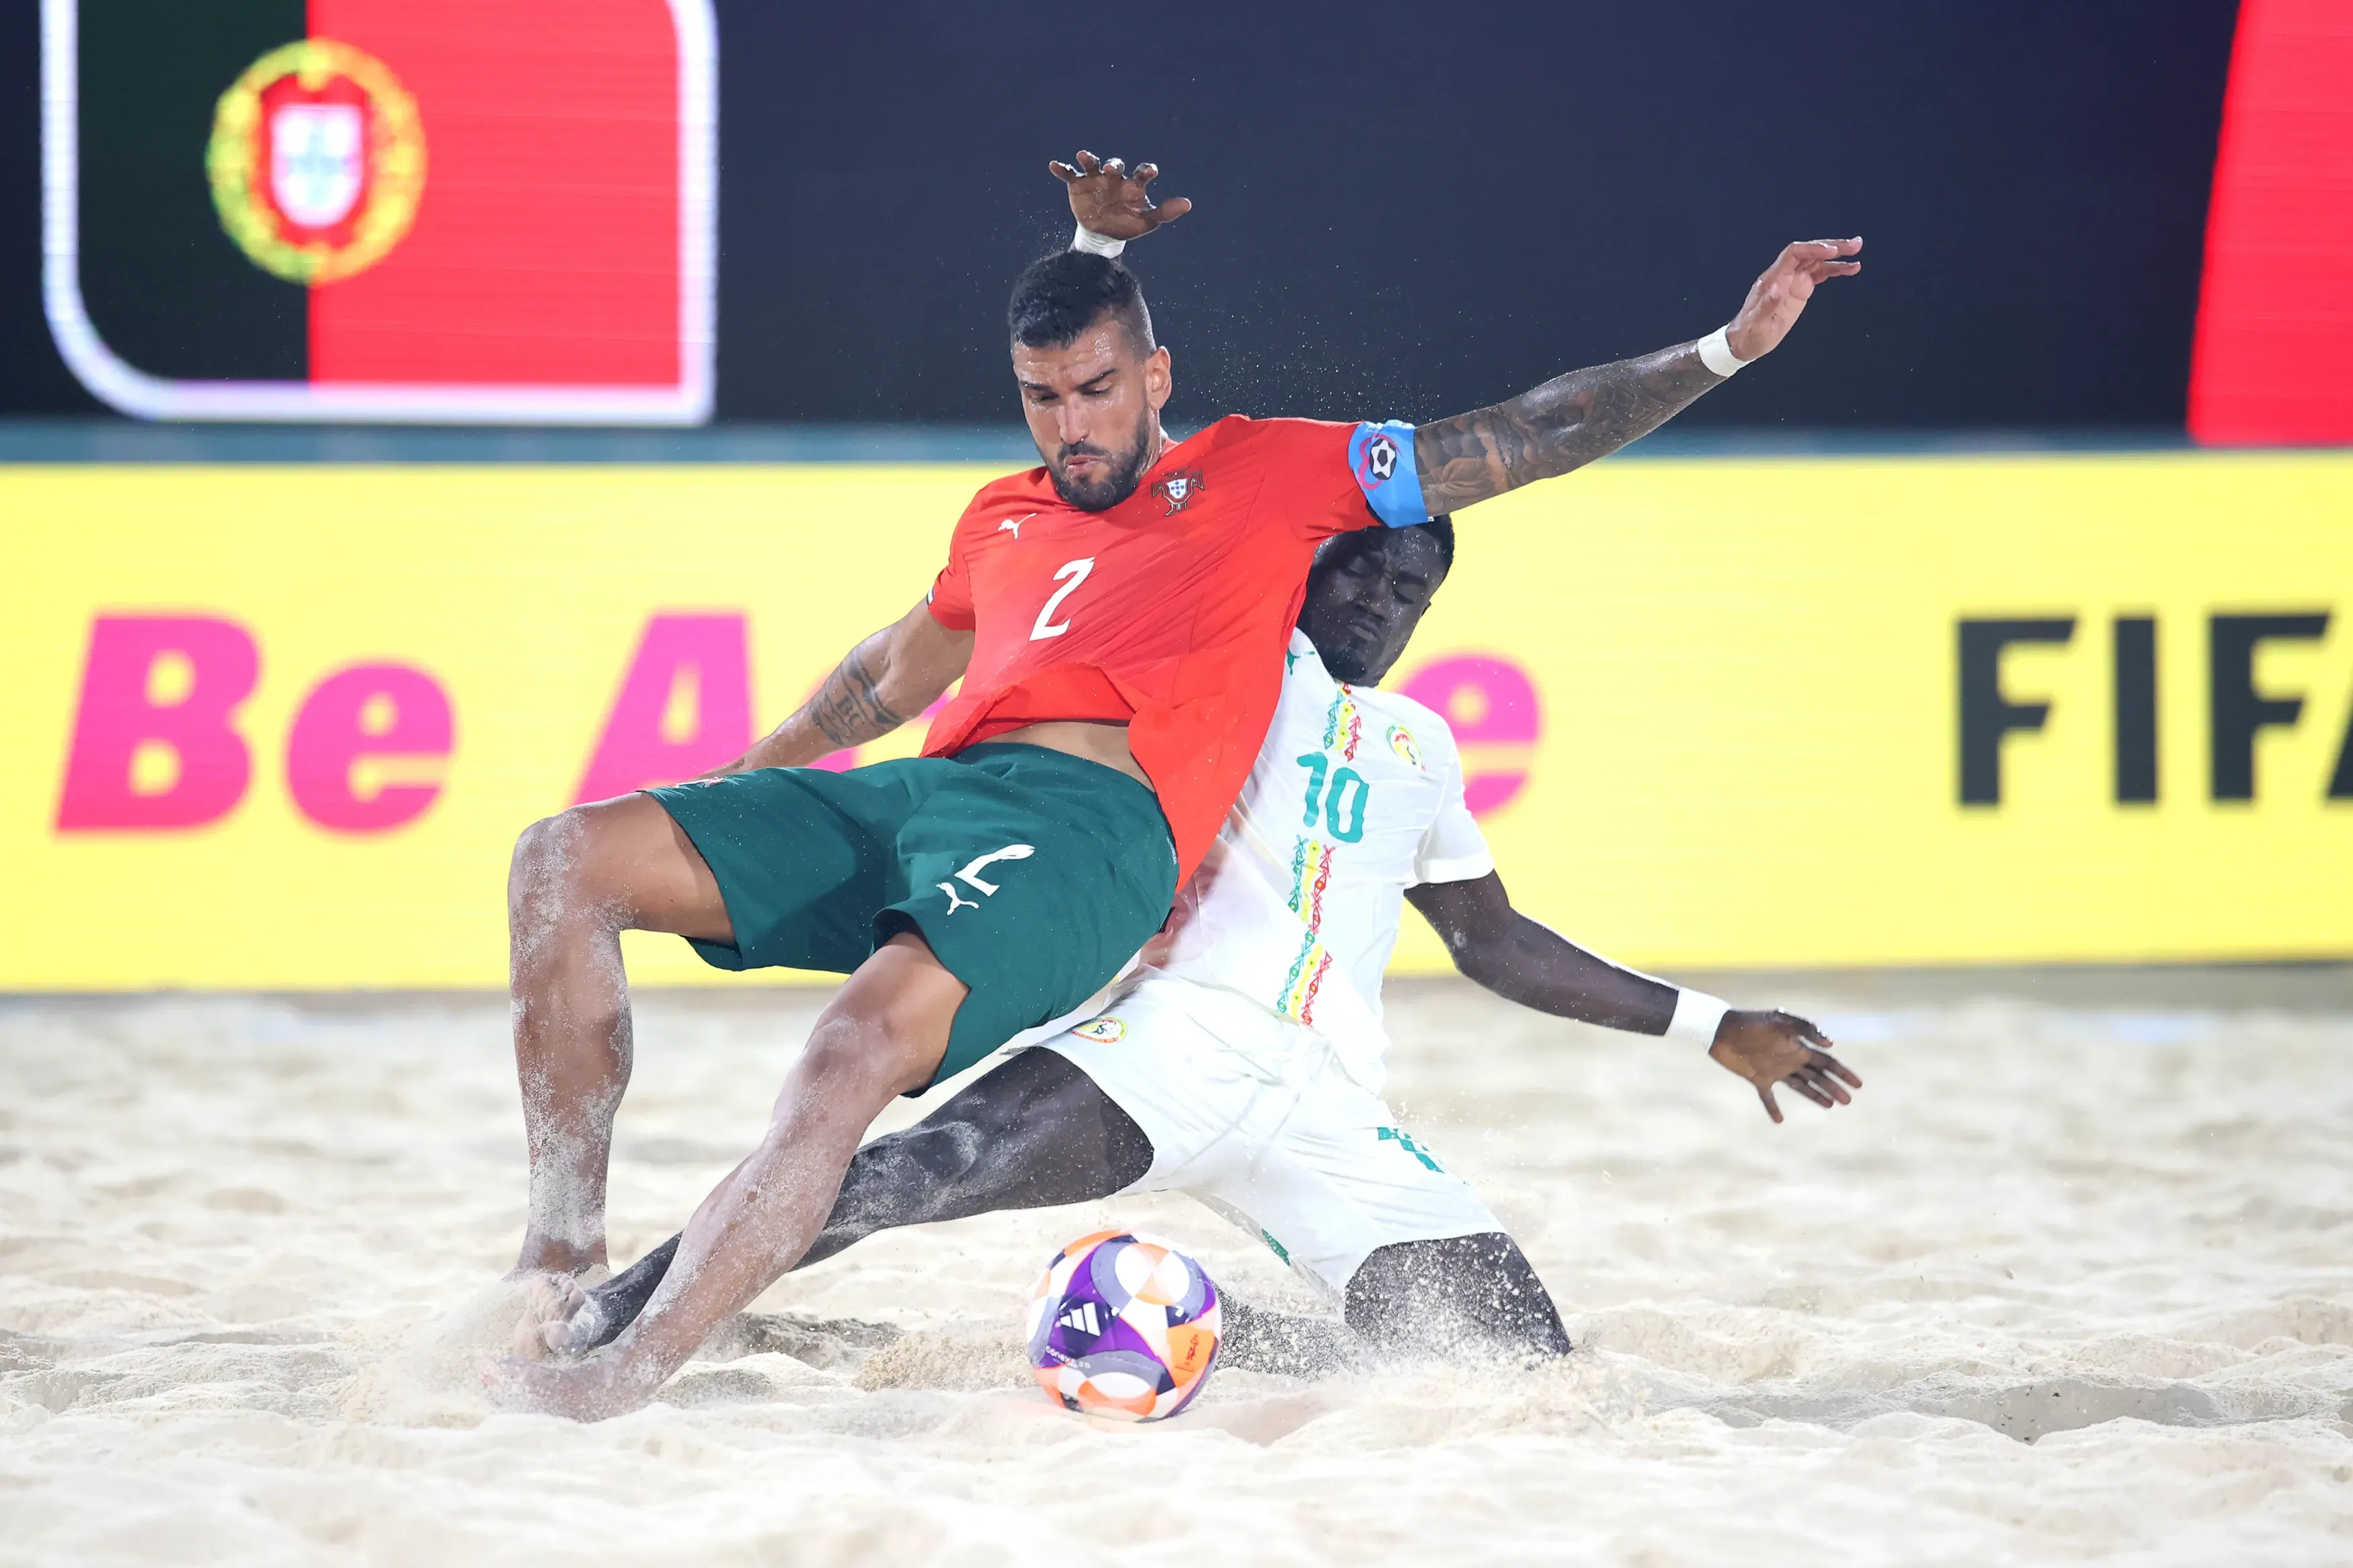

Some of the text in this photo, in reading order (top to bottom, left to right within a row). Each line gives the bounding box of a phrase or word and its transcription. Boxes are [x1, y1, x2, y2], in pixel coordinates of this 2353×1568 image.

[1029, 556, 1095, 641] 2
[54, 611, 458, 837] Be
[1956, 610, 2353, 807] FIF
[1297, 751, 1369, 843] 10
